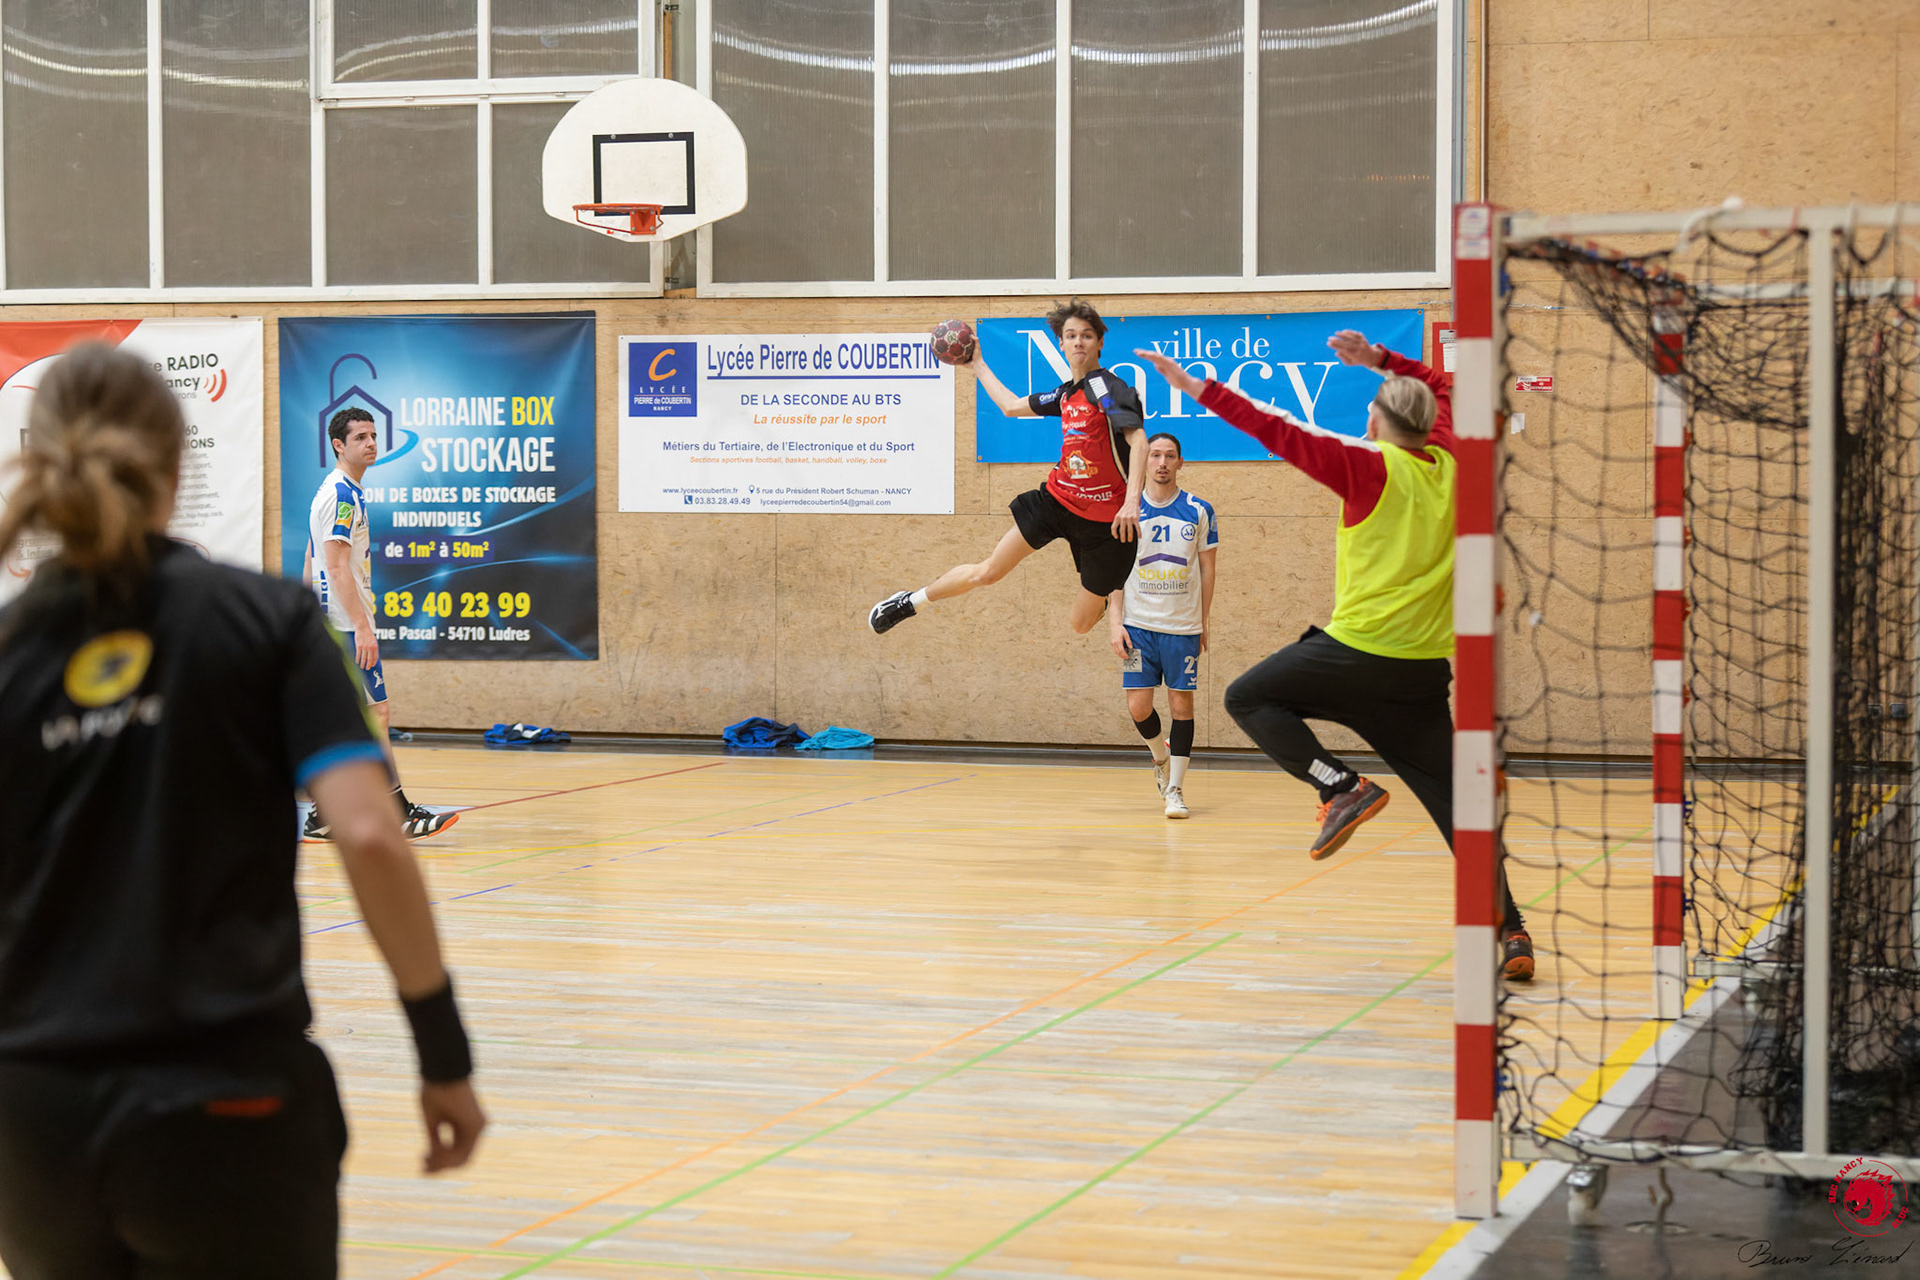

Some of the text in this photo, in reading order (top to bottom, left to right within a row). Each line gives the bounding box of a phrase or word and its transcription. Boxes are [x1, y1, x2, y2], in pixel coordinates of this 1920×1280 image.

[1151, 327, 1270, 359] ville de
[167, 353, 218, 371] RADIO
[707, 343, 940, 376] Lycée Pierre de COUBERTIN
[634, 397, 653, 405] PIERRE
[741, 394, 901, 405] DE LA SECONDE AU BTS
[401, 396, 555, 426] LORRAINE BOX
[753, 413, 887, 427] La réussite par le sport
[421, 437, 556, 473] STOCKAGE
[663, 441, 915, 453] Métiers du Tertiaire, de l'Electronique et du Sport
[721, 456, 753, 464] sportives
[755, 456, 783, 464] football,
[785, 456, 810, 464] basket,
[812, 456, 843, 464] handball,
[846, 456, 868, 465] volley,
[389, 487, 407, 503] DE
[412, 487, 458, 503] BOXES
[462, 487, 481, 503] DE
[485, 486, 556, 503] STOCKAGE
[663, 487, 738, 495] www.lyceecoubertin.fr
[695, 497, 891, 506] 03.83.28.49.49 lyceepierredecoubertin54@gmail.com
[393, 511, 482, 527] INDIVIDUELS
[1151, 525, 1170, 543] 21
[385, 541, 489, 558] de 1m² à 50m²
[1138, 580, 1189, 590] immobilier
[384, 591, 414, 618] 83
[422, 592, 452, 618] 40
[460, 592, 490, 618] 23
[498, 592, 531, 618] 99
[376, 628, 396, 640] rue
[400, 626, 436, 640] Pascal
[447, 626, 485, 641] 54710
[489, 626, 531, 641] Ludres
[1184, 655, 1198, 674] 2
